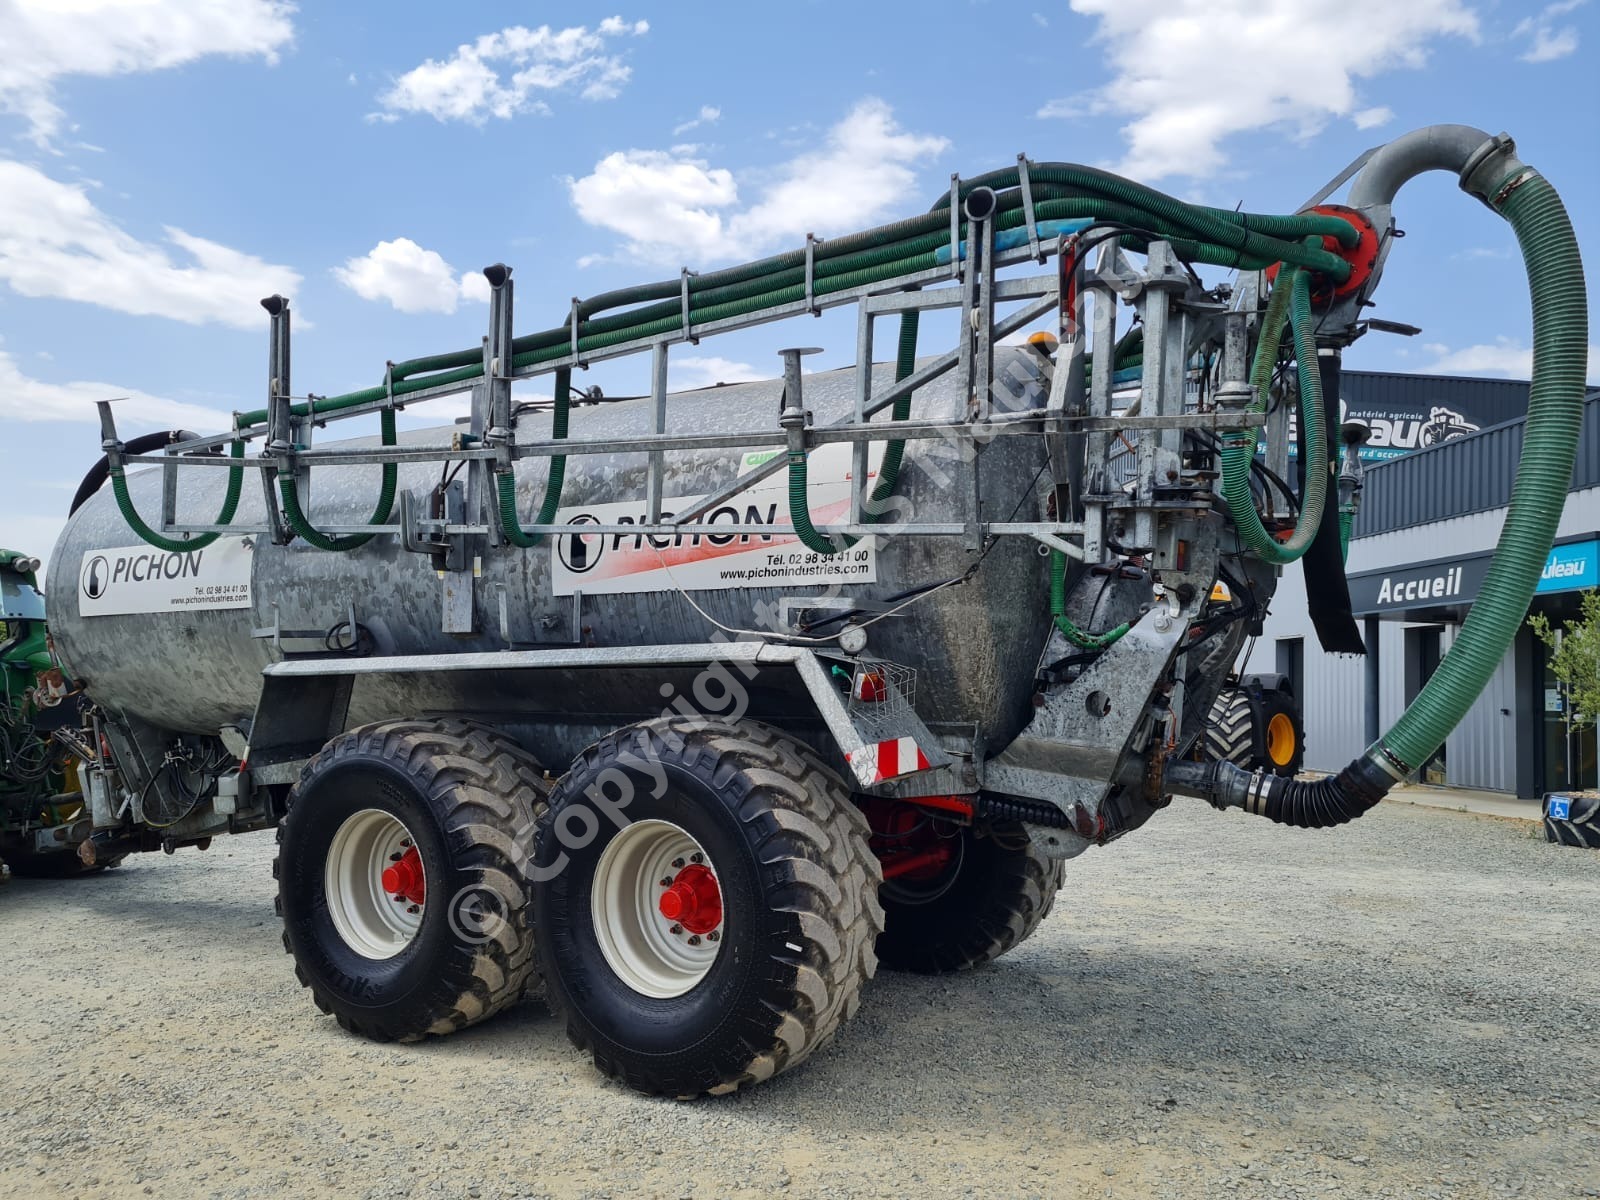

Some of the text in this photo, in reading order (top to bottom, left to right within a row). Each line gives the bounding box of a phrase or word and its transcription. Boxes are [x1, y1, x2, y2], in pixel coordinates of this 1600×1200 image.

[1349, 410, 1424, 420] matériel agricole
[612, 503, 778, 551] PICHON
[112, 550, 203, 583] PICHON
[767, 550, 868, 566] Tél. 02 98 34 41 00
[1541, 555, 1585, 579] uleau
[720, 564, 869, 581] www.pichonindustries.com
[1376, 566, 1462, 605] Accueil
